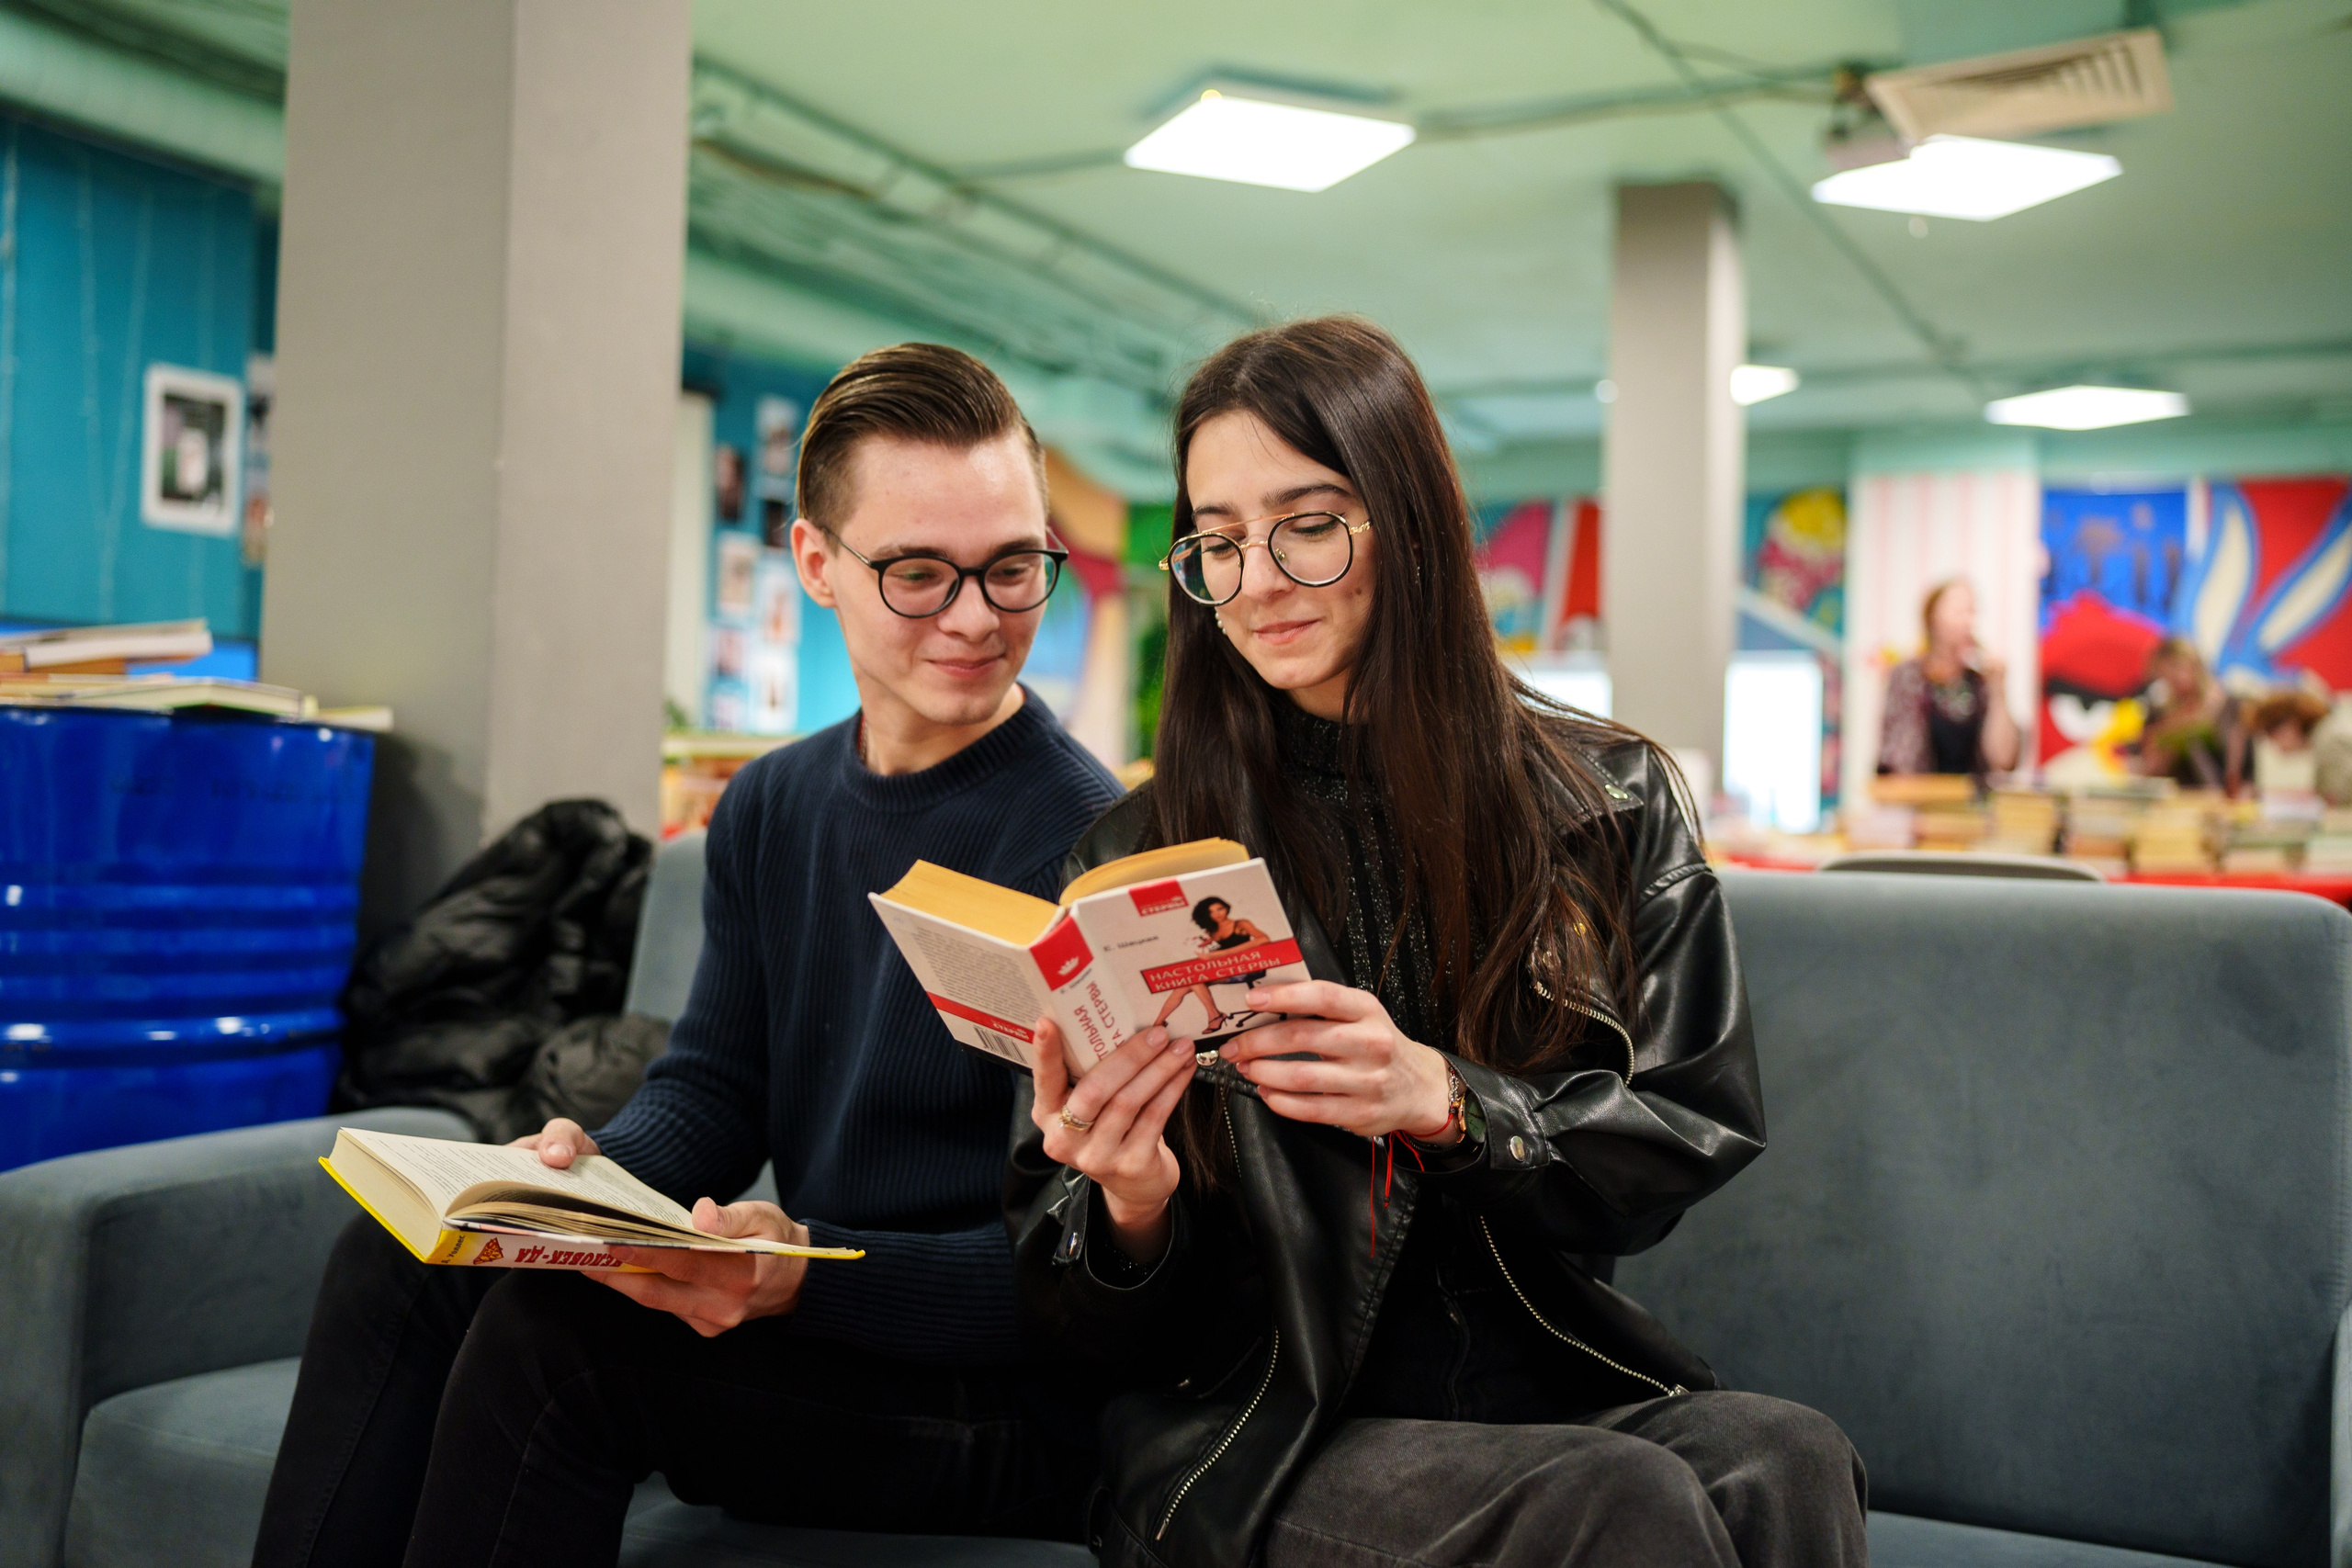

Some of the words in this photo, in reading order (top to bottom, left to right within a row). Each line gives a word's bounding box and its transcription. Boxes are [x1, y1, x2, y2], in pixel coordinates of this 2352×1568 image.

[1149, 951, 1261, 982] НАСТОЛЬНАЯ
[1155, 974, 1209, 991] КНИГА
[1216, 958, 1281, 977] СТЕРВЫ
[1086, 980, 1115, 1029] СТЕРВЫ
[1074, 1005, 1109, 1061] ТОЛЬНАЯ
